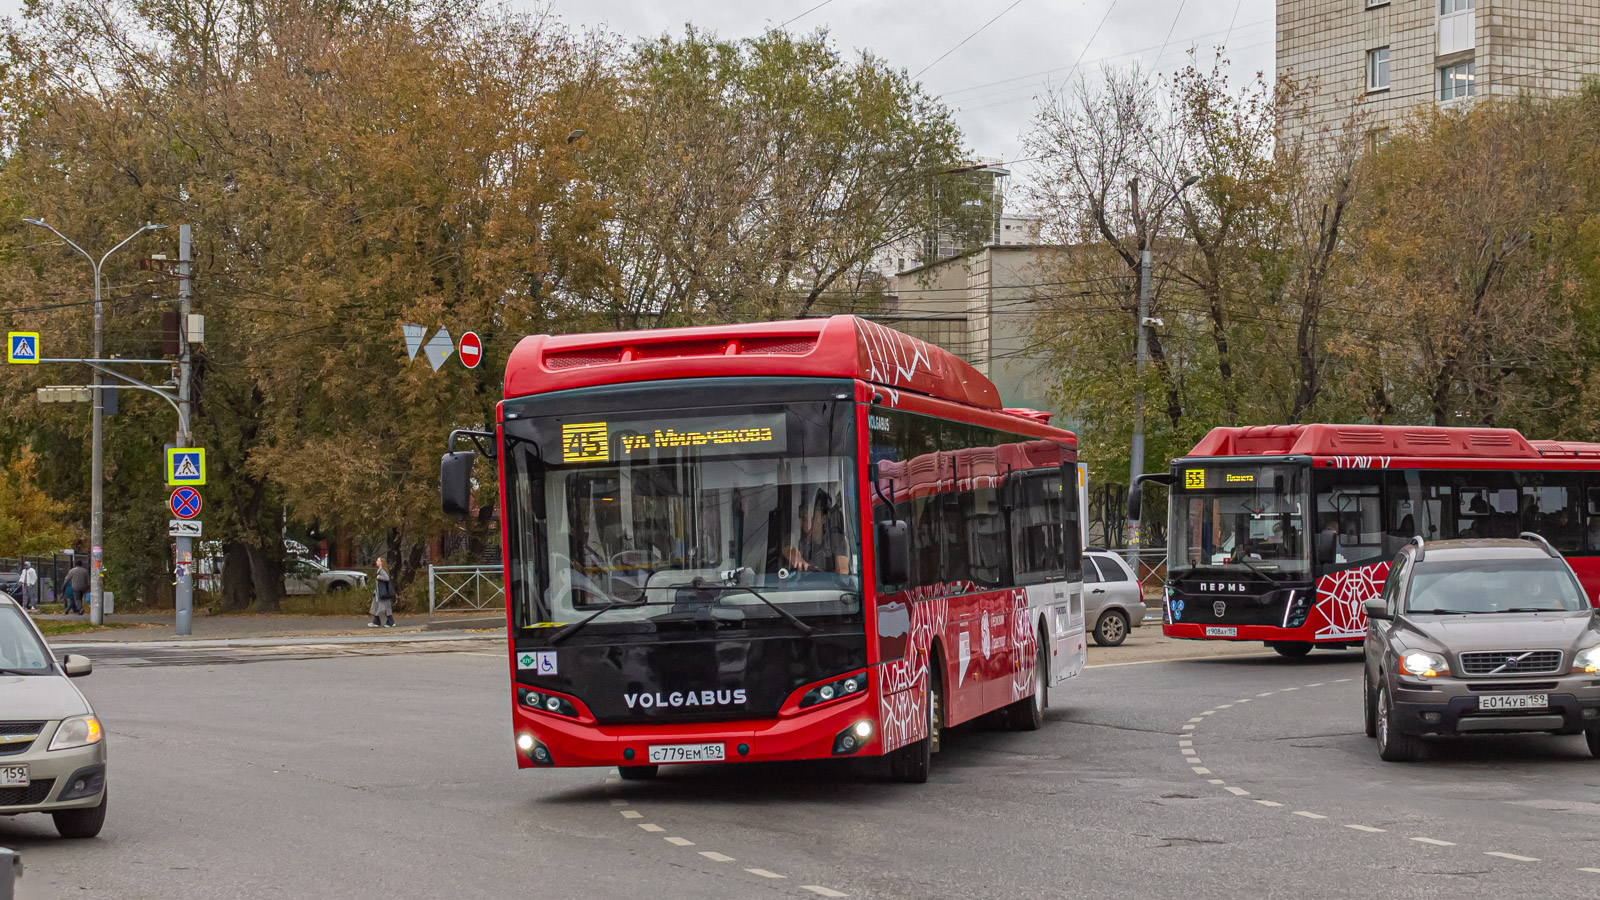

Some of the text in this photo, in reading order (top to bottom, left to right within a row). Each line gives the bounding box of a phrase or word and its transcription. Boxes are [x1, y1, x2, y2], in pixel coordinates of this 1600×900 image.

[566, 430, 601, 458] 45
[654, 428, 773, 448] Мильчакова
[1188, 471, 1254, 486] 55 Планета
[1200, 582, 1246, 592] ПЕРМЬ
[623, 689, 747, 708] VOLGABUS
[1482, 694, 1545, 708] Е014УВ 159
[653, 745, 721, 761] С779ЕМ 159
[3, 767, 24, 778] 159
